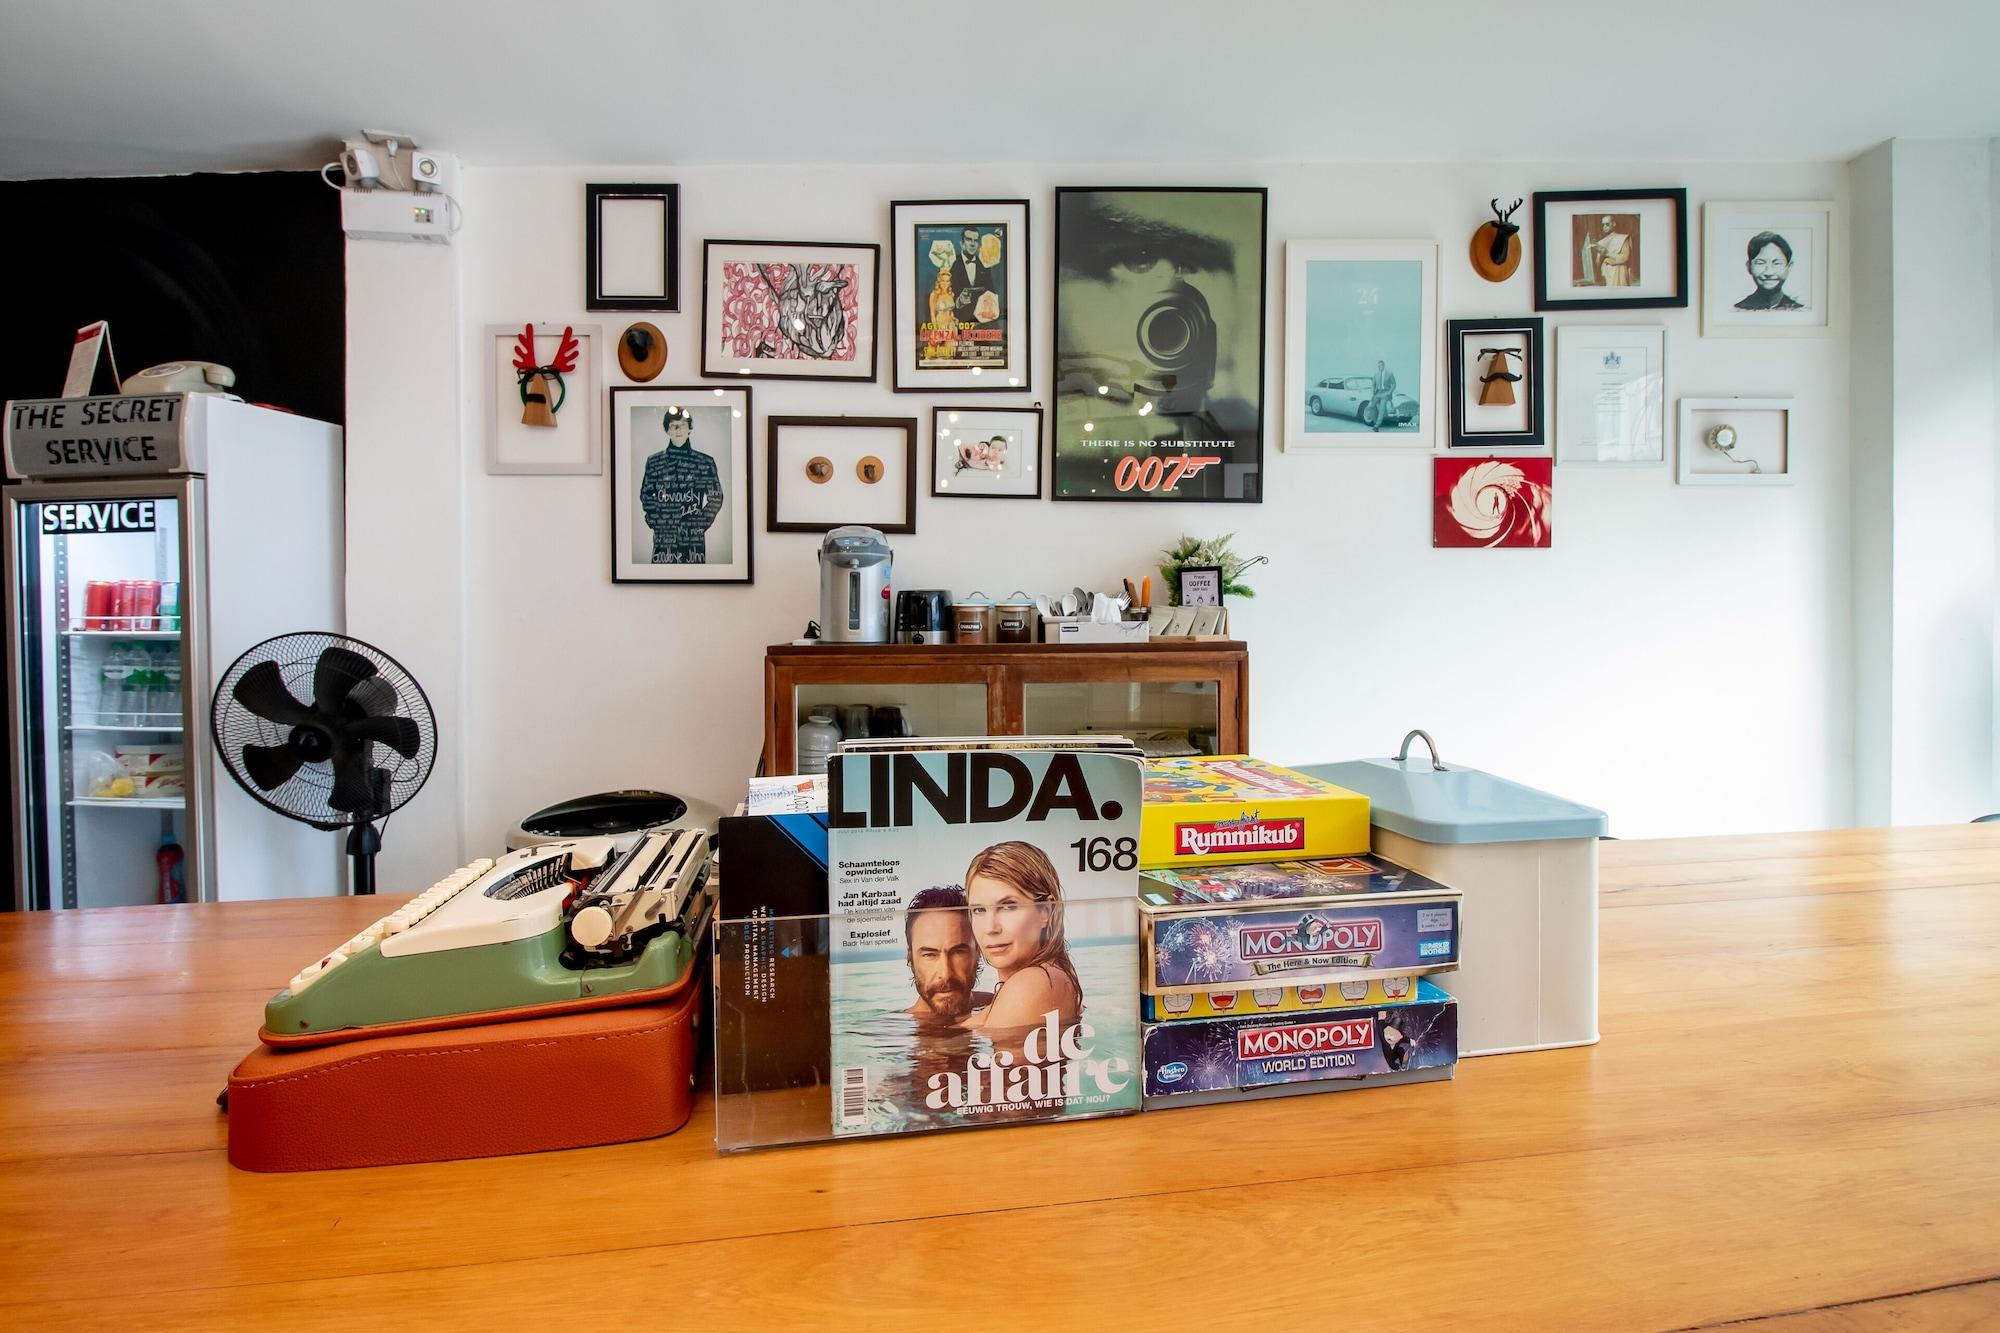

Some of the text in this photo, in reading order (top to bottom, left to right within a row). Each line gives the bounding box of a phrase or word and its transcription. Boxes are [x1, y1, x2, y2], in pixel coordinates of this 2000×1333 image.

[958, 322, 976, 330] 007
[12, 398, 181, 429] THE SECRET
[45, 435, 158, 466] SERVICE
[1080, 439, 1120, 447] THERE
[1160, 440, 1235, 448] SUBSTITUTE
[1114, 456, 1190, 492] 007
[657, 488, 701, 506] Obviously
[42, 502, 156, 532] SERVICE
[829, 752, 1124, 829] LINDA.
[1180, 823, 1299, 855] Rummikub
[838, 859, 900, 869] Schaamteloos
[1070, 836, 1138, 873] 168
[845, 867, 894, 877] opwindend
[856, 898, 879, 907] altijd
[880, 897, 902, 905] zaad
[861, 890, 896, 899] Karbaat
[743, 914, 751, 941] VDEO
[850, 929, 891, 939] Explosief
[874, 937, 899, 946] spreekt
[1245, 925, 1377, 956] MONOPOLY
[1267, 963, 1281, 971] The
[1283, 960, 1301, 968] Here
[1312, 957, 1330, 965] Now
[1331, 956, 1359, 964] Edition
[1023, 1008, 1096, 1064] de
[1243, 1023, 1370, 1055] MONOPOLY
[1261, 1058, 1307, 1073] WORLD
[1310, 1053, 1356, 1069] EDITION
[925, 1050, 1131, 1109] affaire
[956, 1094, 1111, 1115] EEUWIG TROUW, WIE IS DAT NOU?
